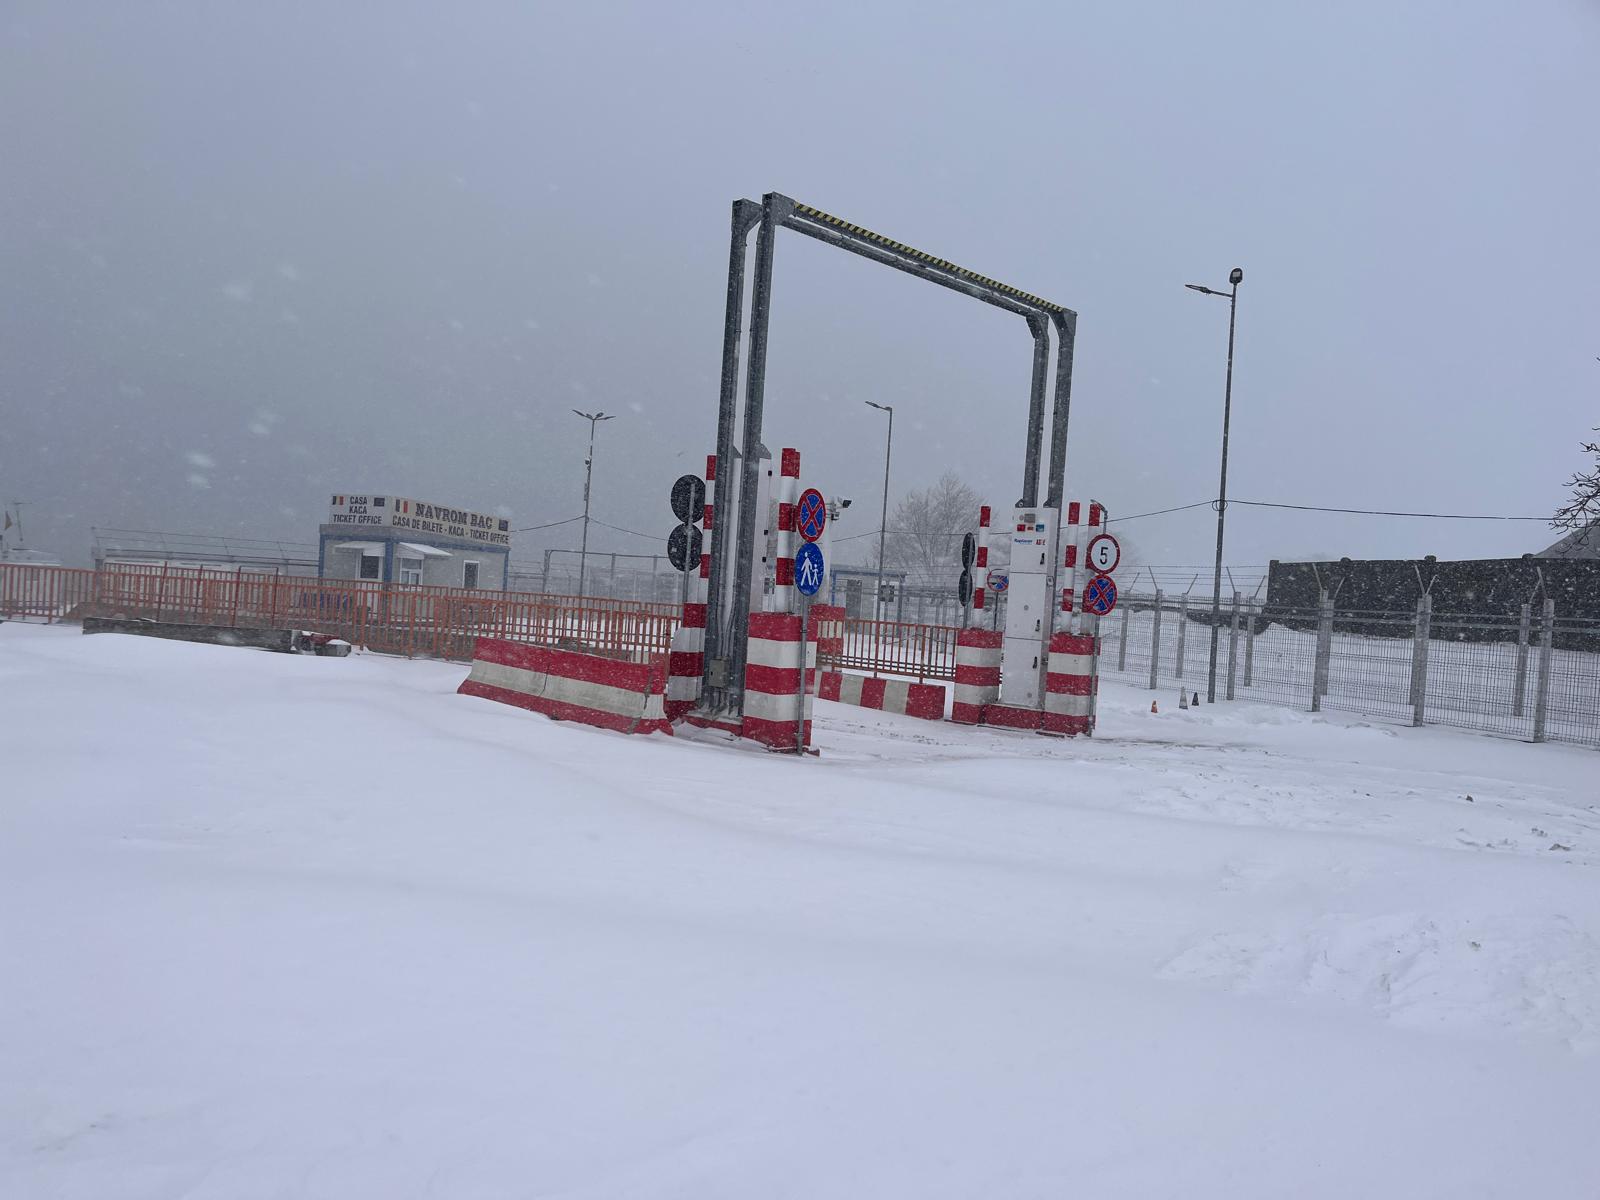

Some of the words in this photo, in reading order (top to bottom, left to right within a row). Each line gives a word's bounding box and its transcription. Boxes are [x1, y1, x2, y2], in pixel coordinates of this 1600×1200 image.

[350, 496, 368, 505] CASA
[333, 514, 356, 523] TICKET
[416, 503, 468, 525] NAVROM
[470, 514, 492, 530] BAC
[392, 515, 410, 528] CASA
[412, 518, 420, 530] DE
[422, 520, 443, 534] BILETE
[470, 529, 489, 540] TICKET
[490, 532, 510, 544] OFFICE
[1100, 546, 1108, 565] 5
